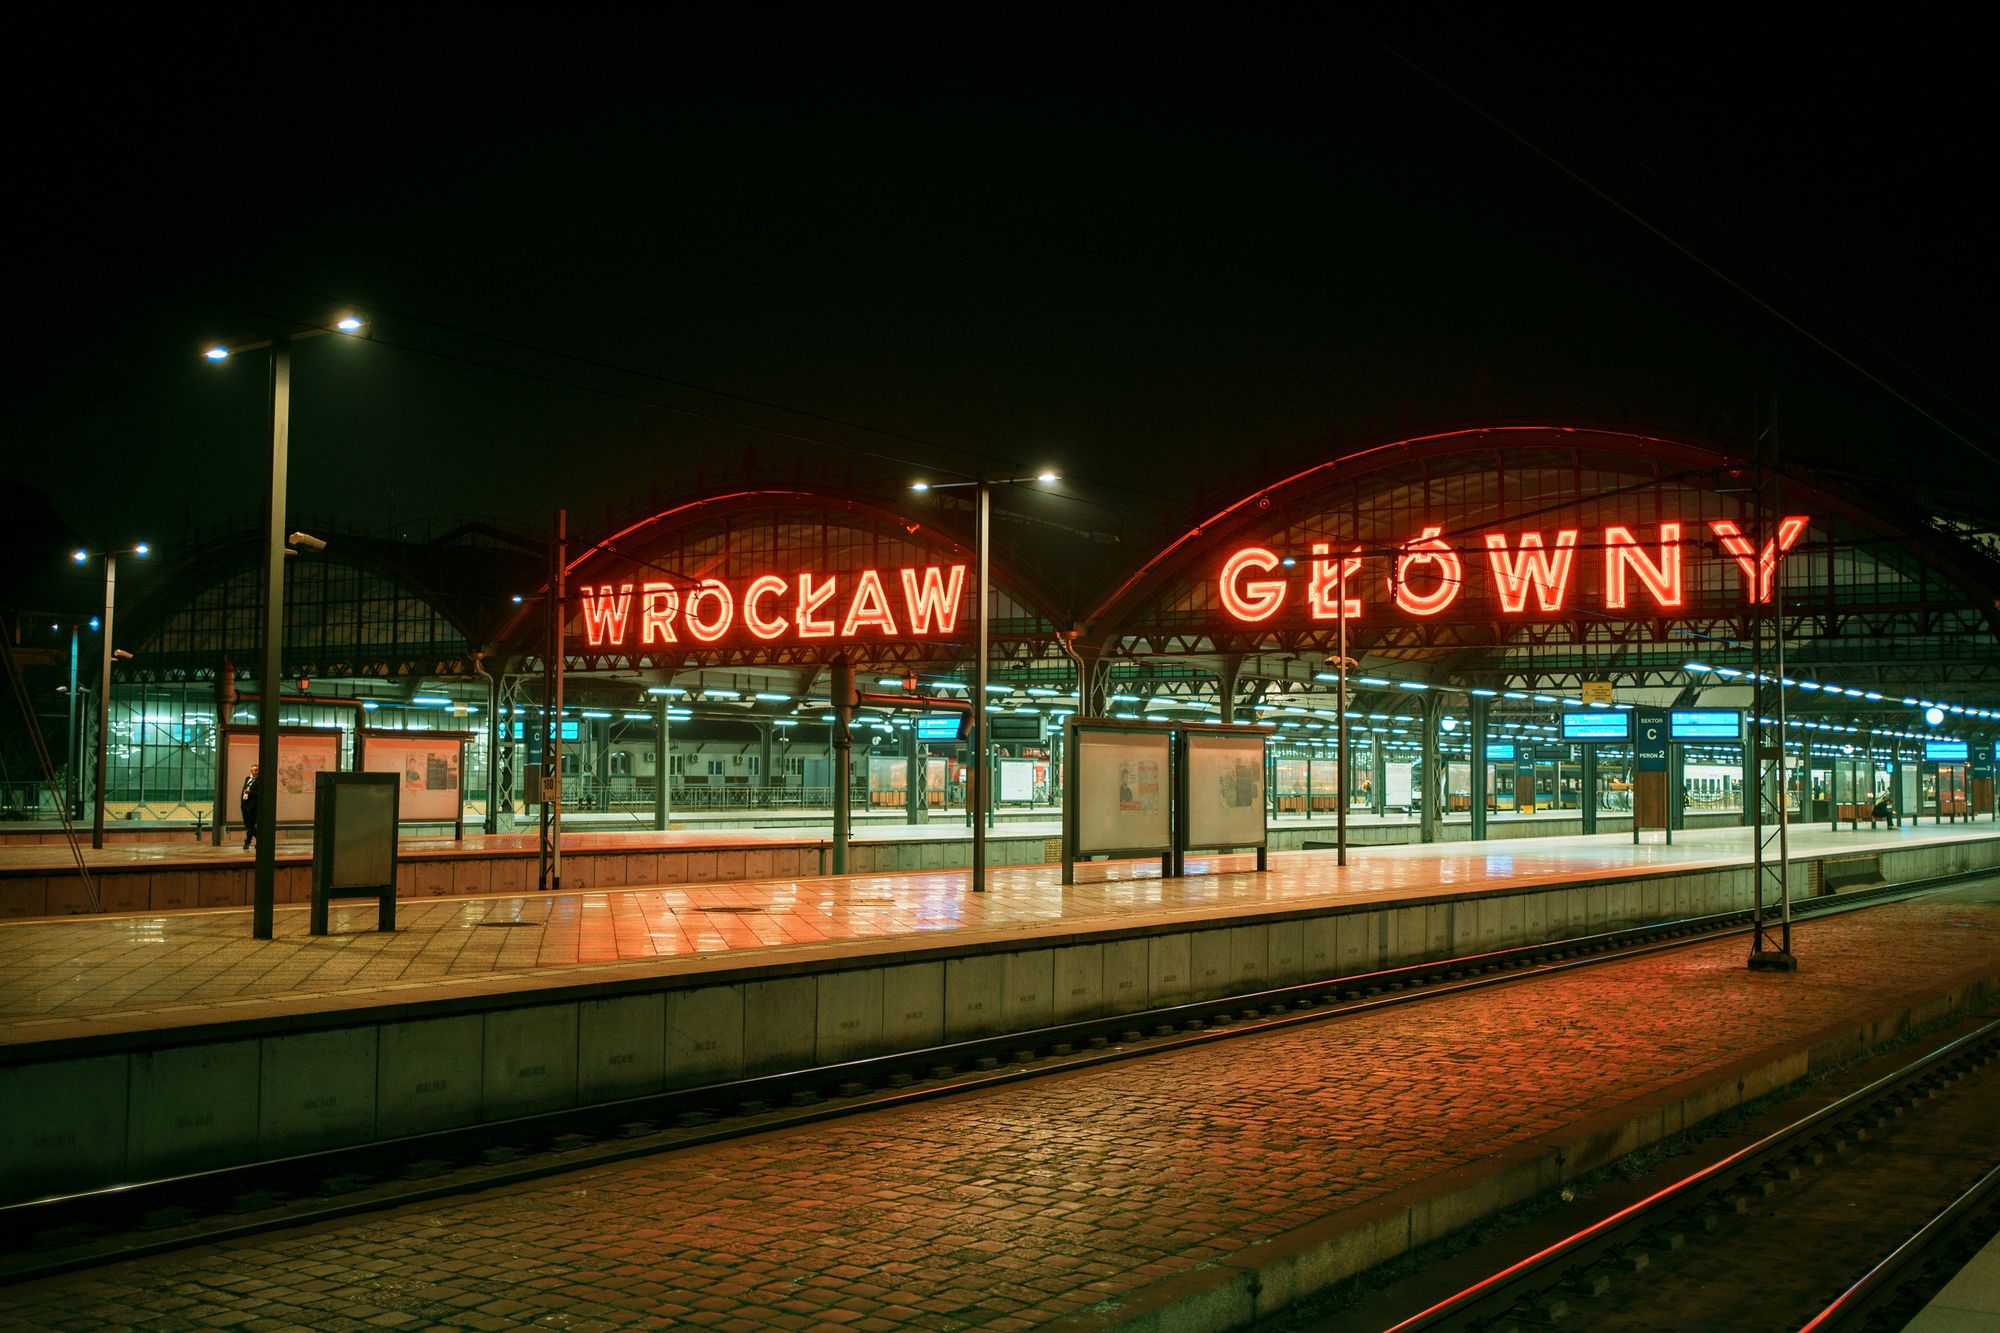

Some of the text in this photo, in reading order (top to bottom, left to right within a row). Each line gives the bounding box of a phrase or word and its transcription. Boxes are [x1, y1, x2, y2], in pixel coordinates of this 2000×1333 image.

[1218, 515, 1810, 622] GŁÓWNY
[579, 564, 967, 646] WROCŁAW
[534, 733, 540, 741] C
[1647, 729, 1657, 740] C
[1658, 750, 1665, 759] 2
